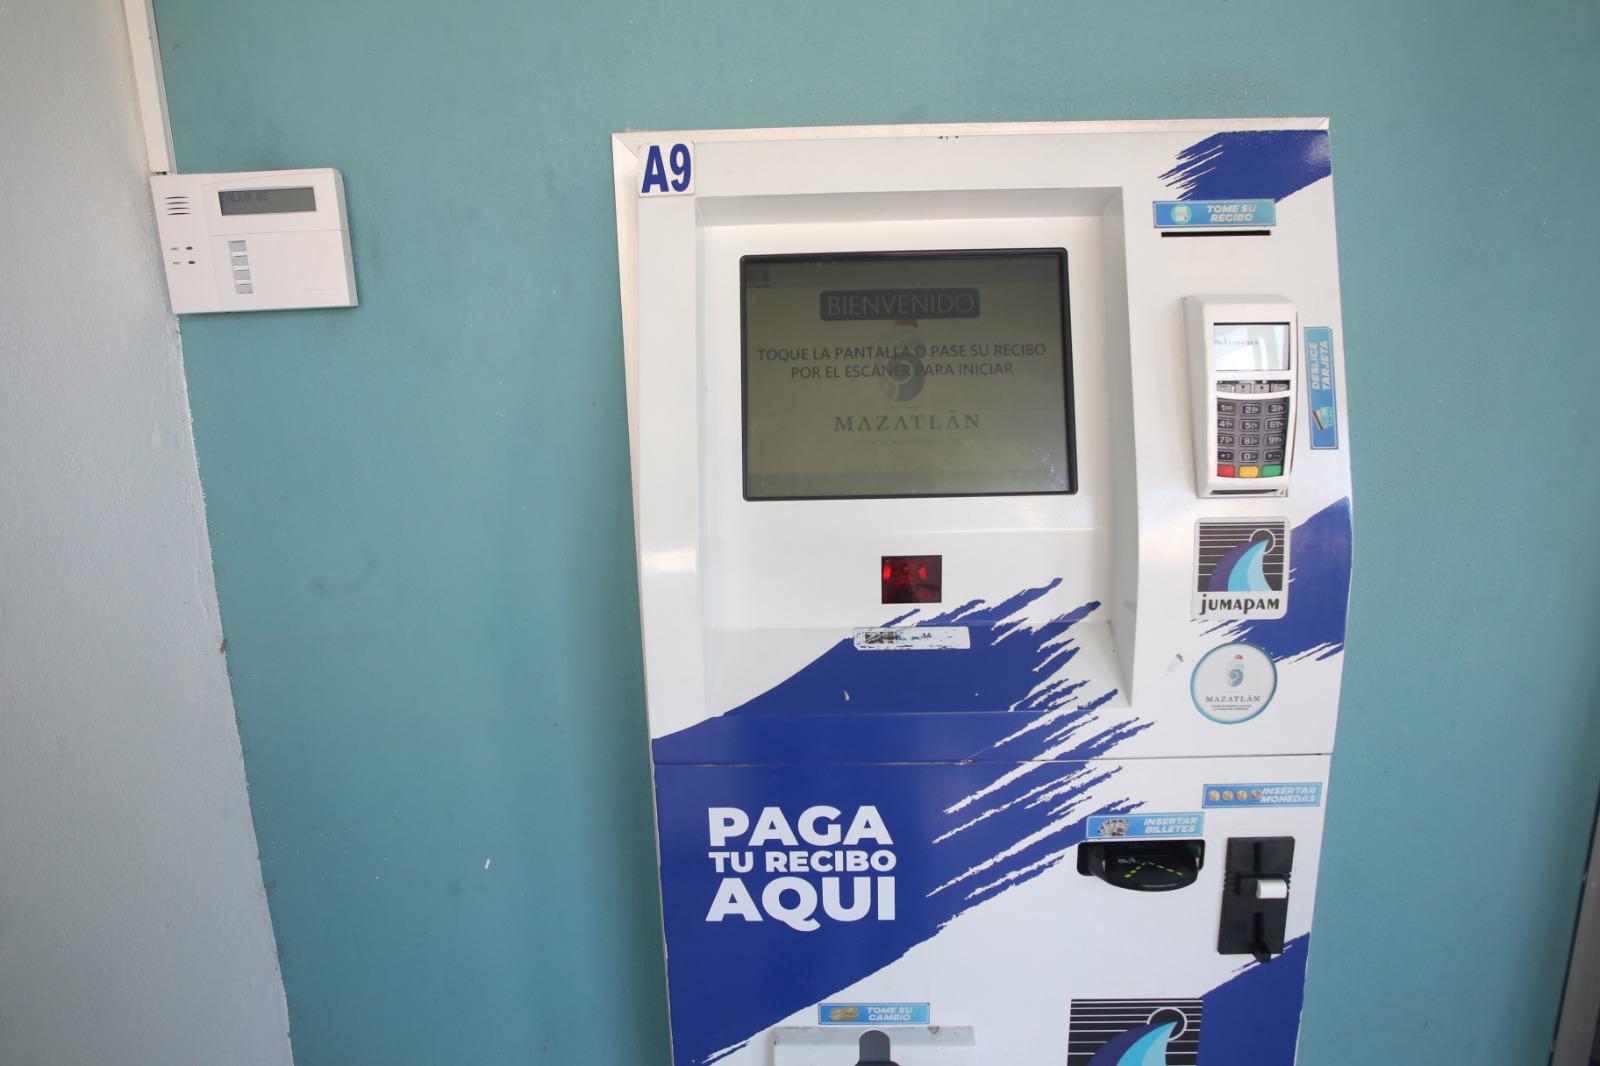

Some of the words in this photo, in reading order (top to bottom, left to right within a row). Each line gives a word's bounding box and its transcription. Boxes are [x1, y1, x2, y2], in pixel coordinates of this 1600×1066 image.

[641, 143, 691, 193] A9
[1207, 204, 1239, 214] TOME
[1241, 204, 1256, 213] SU
[1210, 213, 1253, 222] RECIBO
[827, 293, 974, 316] BIENVENIDO
[757, 347, 809, 363] TOQUE
[813, 347, 831, 360] LA
[835, 345, 913, 360] PANTALLA
[915, 344, 926, 358] O
[930, 344, 966, 358] PASE
[970, 344, 989, 357] SU
[994, 343, 1046, 357] RECIBO
[791, 366, 822, 379] POR
[825, 366, 841, 378] EL
[916, 363, 955, 377] PARA
[959, 362, 1014, 376] INICIAR
[1309, 341, 1320, 389] DESLICE
[1320, 341, 1331, 390] TARJETA
[1260, 795, 1316, 803] MONEDAS
[1262, 787, 1316, 796] INSERTAR
[708, 805, 894, 847] PAGA
[1144, 817, 1198, 826] INSERTAR
[1145, 825, 1196, 833] BILLETES
[709, 851, 754, 873] TU
[765, 850, 897, 873] RECIBO
[705, 876, 896, 932] AQUI
[867, 1006, 896, 1014] TOME
[899, 1006, 912, 1014] SU
[868, 1013, 911, 1022] CAMBIO
